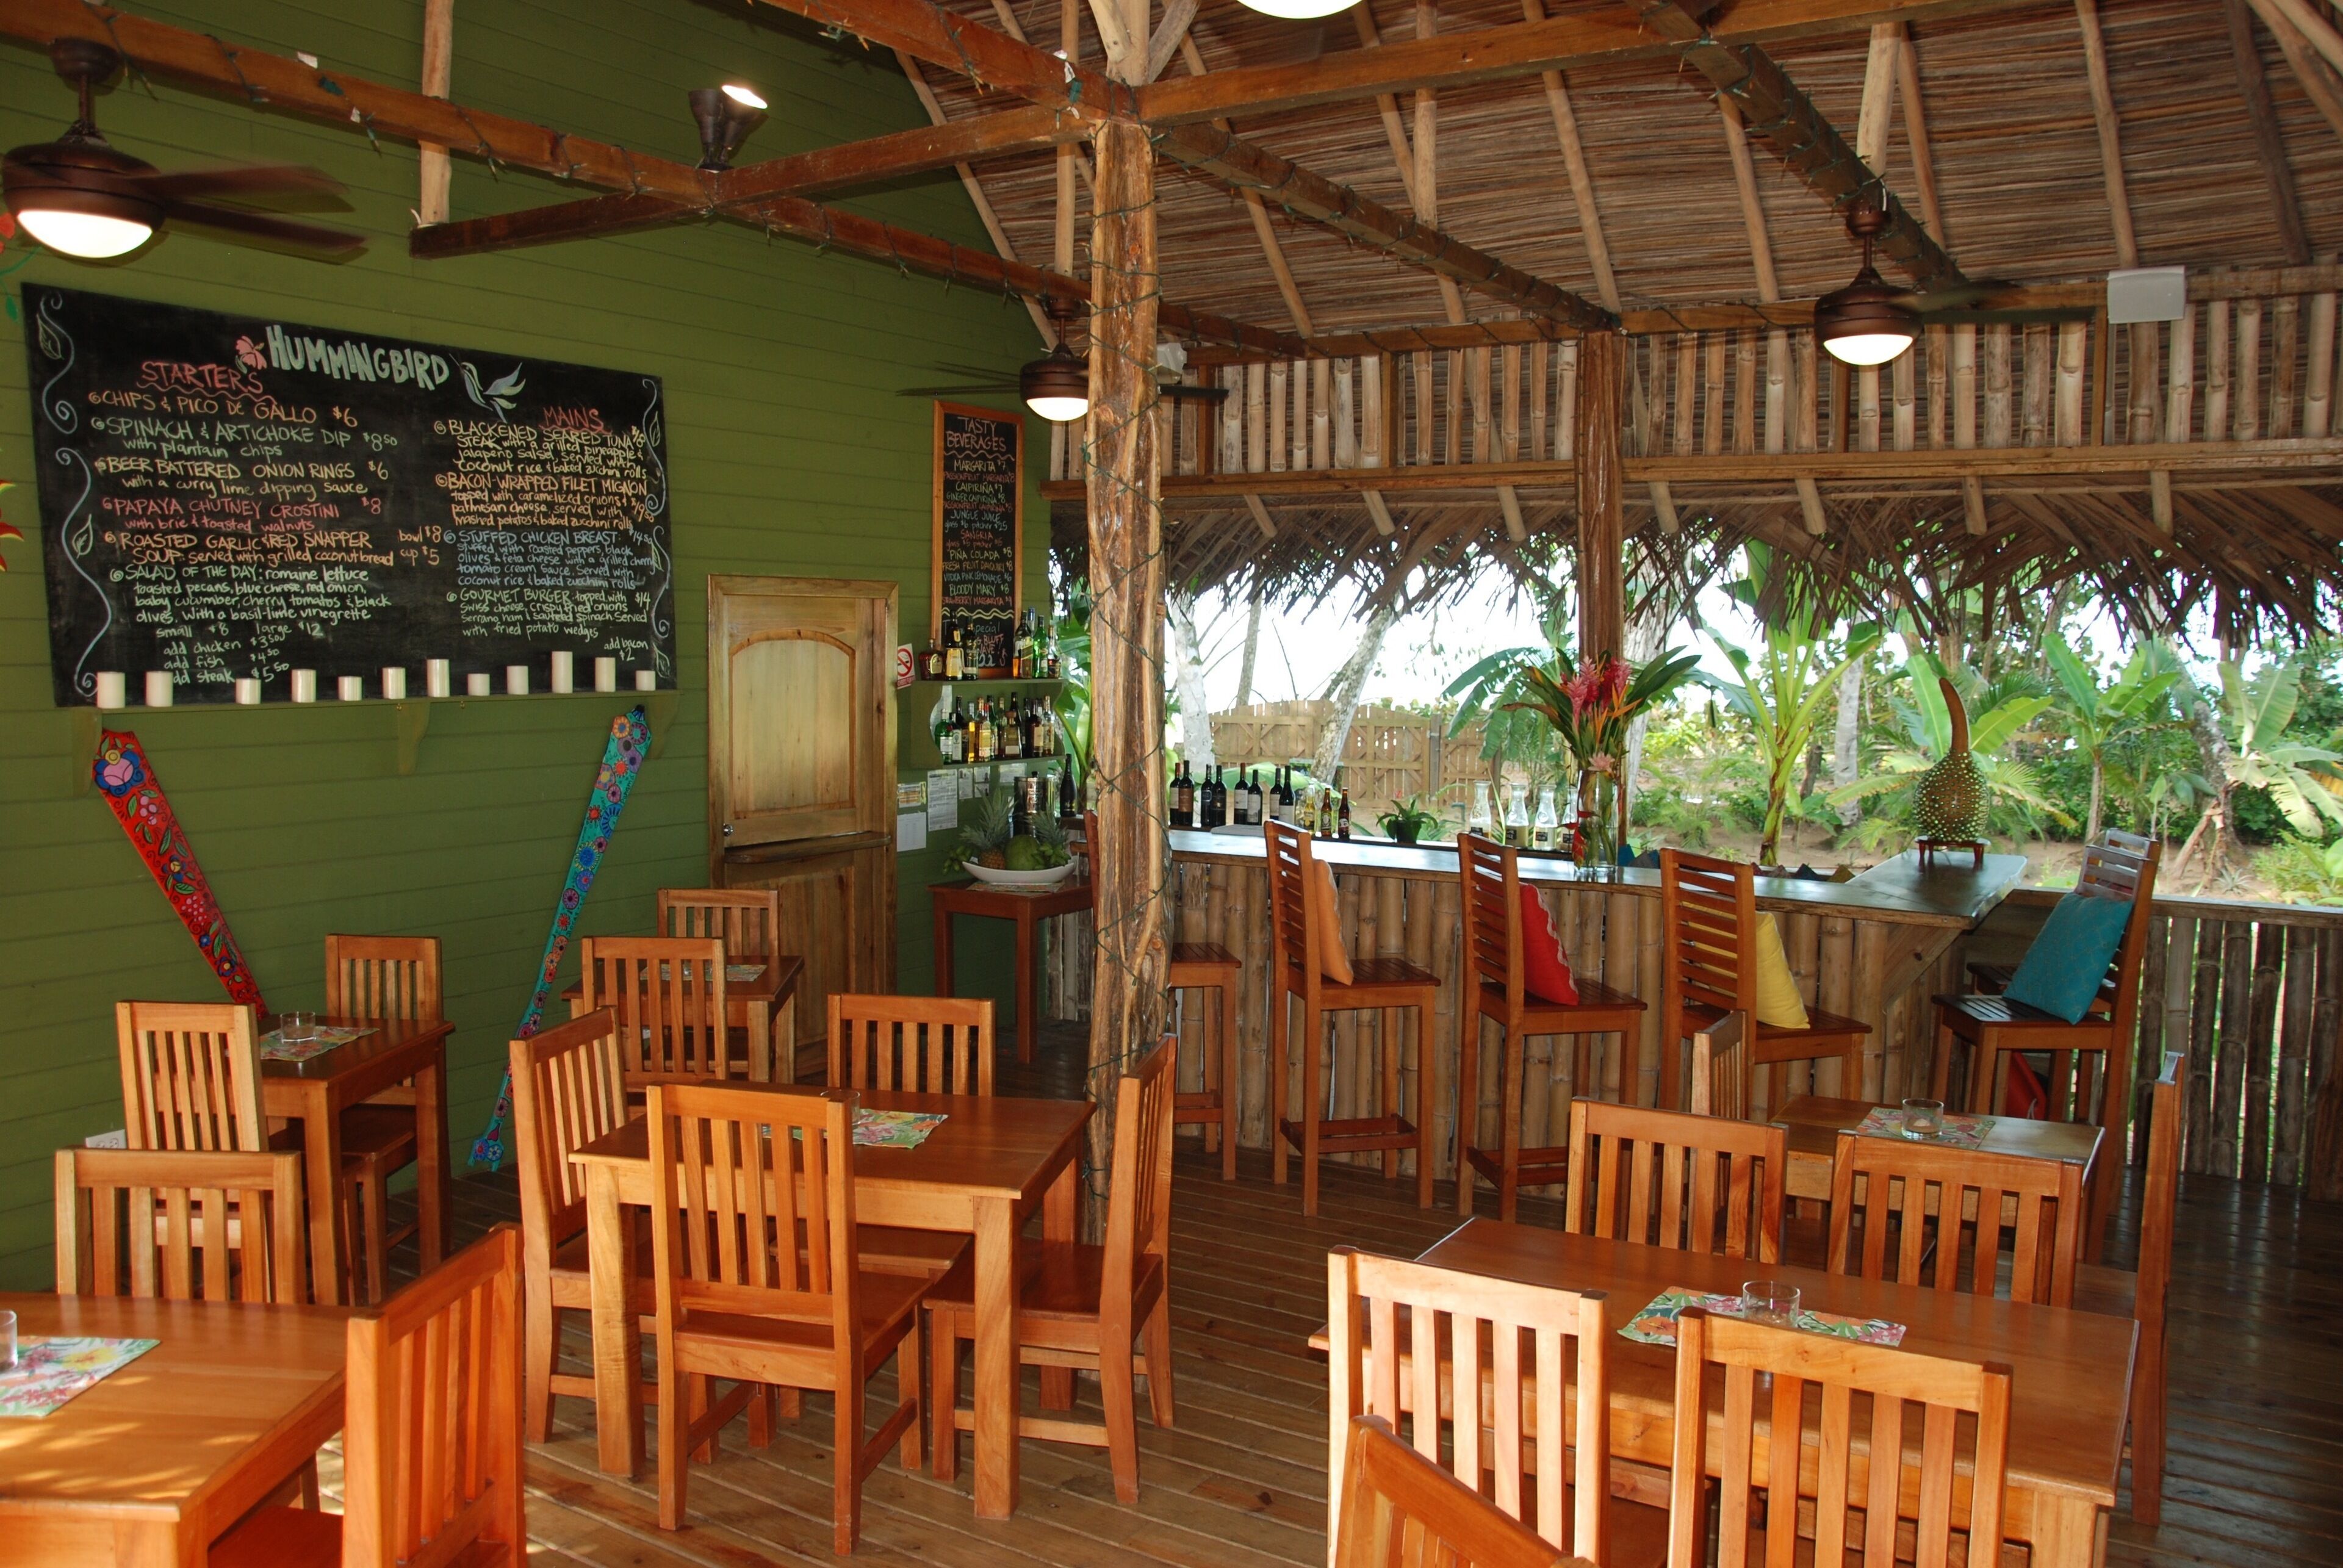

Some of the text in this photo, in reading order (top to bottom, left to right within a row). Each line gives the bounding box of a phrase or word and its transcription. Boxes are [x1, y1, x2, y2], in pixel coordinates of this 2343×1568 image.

[265, 325, 450, 391] HUMMINGBIRD
[141, 361, 263, 394] STARTERS
[102, 390, 358, 427] CHIPS PICO GALLO $6
[543, 406, 604, 430] MAINS
[106, 417, 351, 448] SPINACH ARTICHOKE DIP
[448, 419, 634, 450] BLACKENED SEARED TUNA
[957, 417, 996, 437] TASTY
[457, 435, 637, 458] STEAK with grilled pineapple
[946, 430, 1006, 451] BEVERAGES
[123, 437, 283, 464] with plantain chips
[107, 456, 389, 480] BEER BATTERED ONION RINGS $6
[561, 451, 636, 469] served with
[954, 459, 1006, 472] MARGARITA $7
[518, 461, 646, 478] rice baked rolls
[122, 474, 369, 502] with a curry lime dipping sauce
[447, 472, 648, 496] BACON-WRAPPED FILET MIGNON
[956, 481, 1002, 494] CAIPIRIÑA $7
[450, 489, 619, 506] topped with caramelized onions
[946, 491, 1006, 503] GINGER $8
[114, 496, 381, 519] PAPAYA CHUTNEY CROSTINI $8
[553, 505, 623, 519] served with
[125, 515, 315, 534] with brie toasted walnuts
[455, 513, 632, 530] mashed baked zucchini rolls
[951, 509, 1000, 524] JUNGLE JUICE
[398, 525, 442, 543] bowl $8
[945, 520, 1007, 533] glass $6 pitcher $25
[960, 529, 993, 539] SANGRIA
[121, 530, 372, 550] ROASTED SNAPPER
[459, 529, 569, 546] STUFFED CHICKEN
[189, 547, 312, 567] served with grilled
[400, 545, 440, 567] cup $5
[498, 543, 633, 555] with roasted black
[950, 547, 1012, 560] PIÑA COLADA $8
[458, 552, 628, 567] olives feta cheese with grilled
[943, 561, 1013, 571] FRESH FRUIT $8
[126, 563, 369, 582] SALAD OF THE DAY: romaine lettuce
[456, 563, 501, 575] tomato
[613, 567, 634, 578] with
[975, 571, 1002, 583] LEMONADE
[1004, 573, 1012, 581] $6
[134, 580, 323, 595] toasted blue red
[458, 574, 636, 589] coconut rice baked rolls
[949, 583, 1009, 597] BLOODY MARY $8
[135, 594, 392, 612] baby cherry black
[460, 588, 650, 611] GOURMET with $14
[564, 603, 628, 613] fried onions
[974, 597, 1004, 606] MARGARITA
[217, 607, 371, 625] a basil-lime vinegrette
[156, 621, 324, 641] small $8 large $12
[462, 621, 599, 642] with fried potato wedges
[984, 633, 1004, 646] BLUFF
[164, 641, 241, 655] add chicken
[603, 636, 649, 650] add bacon
[164, 655, 225, 669] add fish
[619, 647, 635, 661] $2
[196, 667, 235, 683] steak
